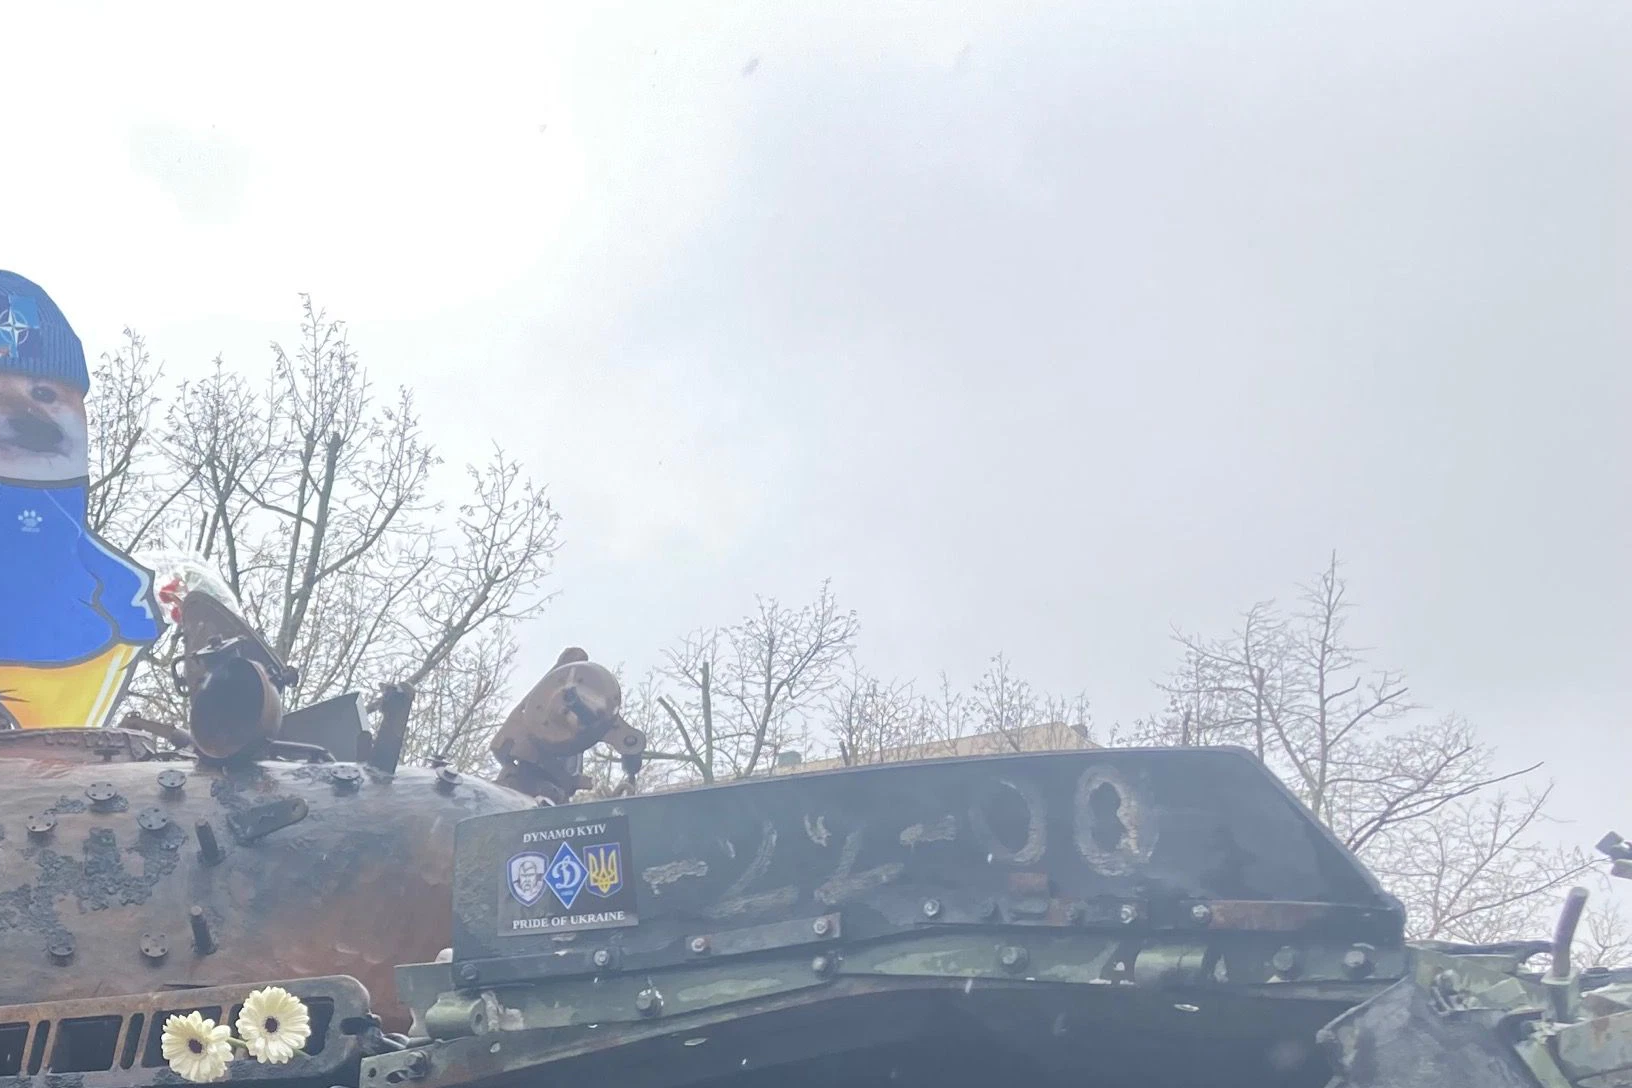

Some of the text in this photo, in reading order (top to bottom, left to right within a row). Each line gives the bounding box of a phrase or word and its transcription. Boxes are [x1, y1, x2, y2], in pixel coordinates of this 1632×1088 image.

[523, 824, 606, 843] DYNAMO KYIV
[512, 911, 625, 930] PRIDE OF UKRAINE
